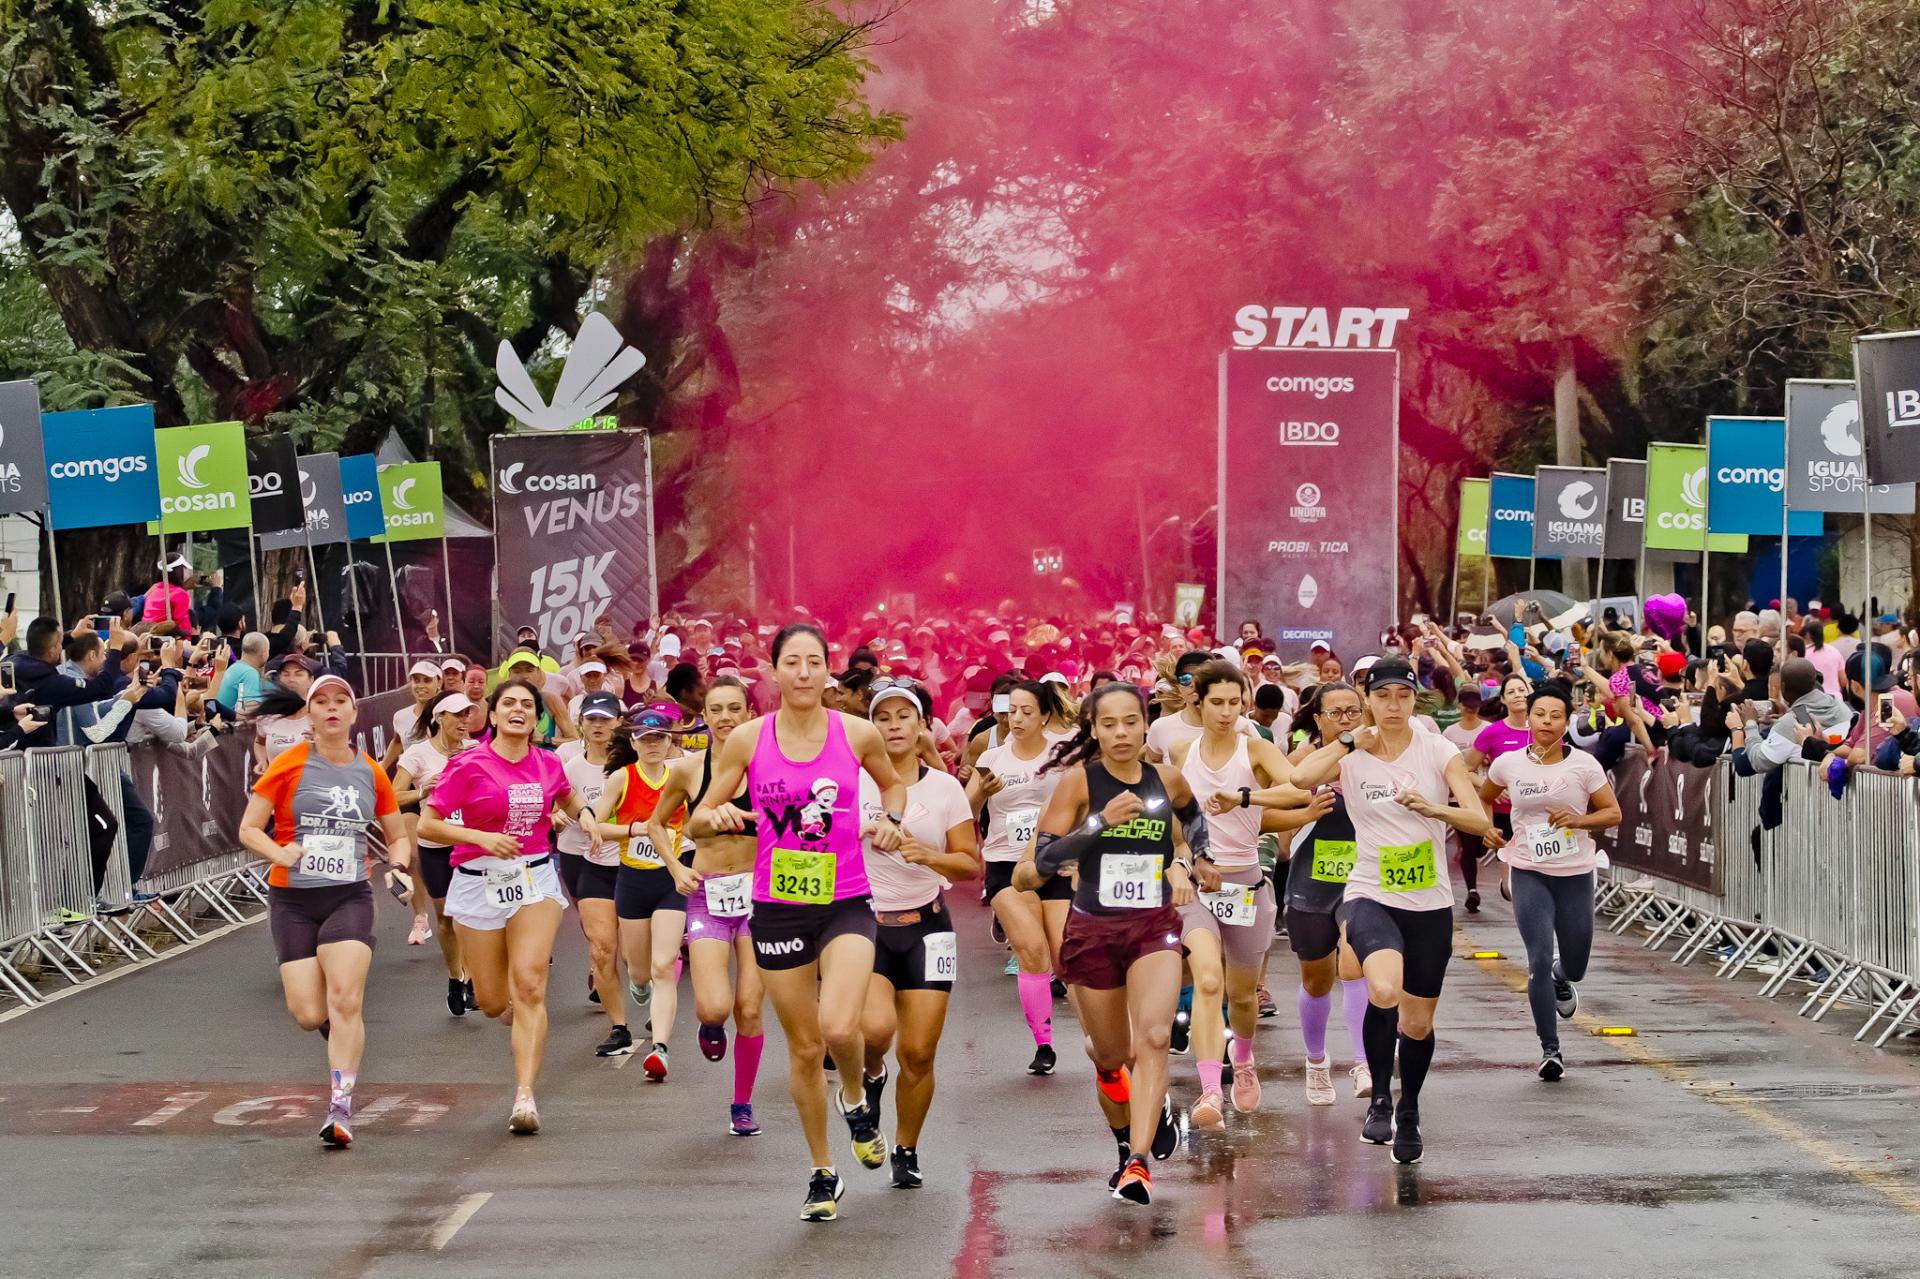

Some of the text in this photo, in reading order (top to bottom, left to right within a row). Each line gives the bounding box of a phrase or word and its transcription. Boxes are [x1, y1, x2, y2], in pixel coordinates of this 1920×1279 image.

[1232, 304, 1410, 348] START
[1266, 376, 1355, 399] comgas
[50, 456, 147, 482] comgas
[525, 473, 597, 492] cosan
[160, 491, 235, 514] cosan
[524, 483, 642, 538] VENUS
[1548, 521, 1604, 534] IGUANA
[1548, 532, 1604, 545] SPORTS
[529, 550, 617, 614] 15K
[538, 597, 612, 650] 10K
[1366, 787, 1398, 801] VENUS
[1015, 827, 1036, 842] 23
[1101, 828, 1164, 841] SQUAD
[1535, 840, 1560, 857] 060
[306, 855, 345, 874] 3068
[776, 874, 821, 897] 3243
[1385, 865, 1425, 886] 3247
[496, 884, 524, 904] 108
[1113, 881, 1146, 901] 091
[718, 896, 746, 912] 171
[756, 937, 804, 955] VAIVÓ
